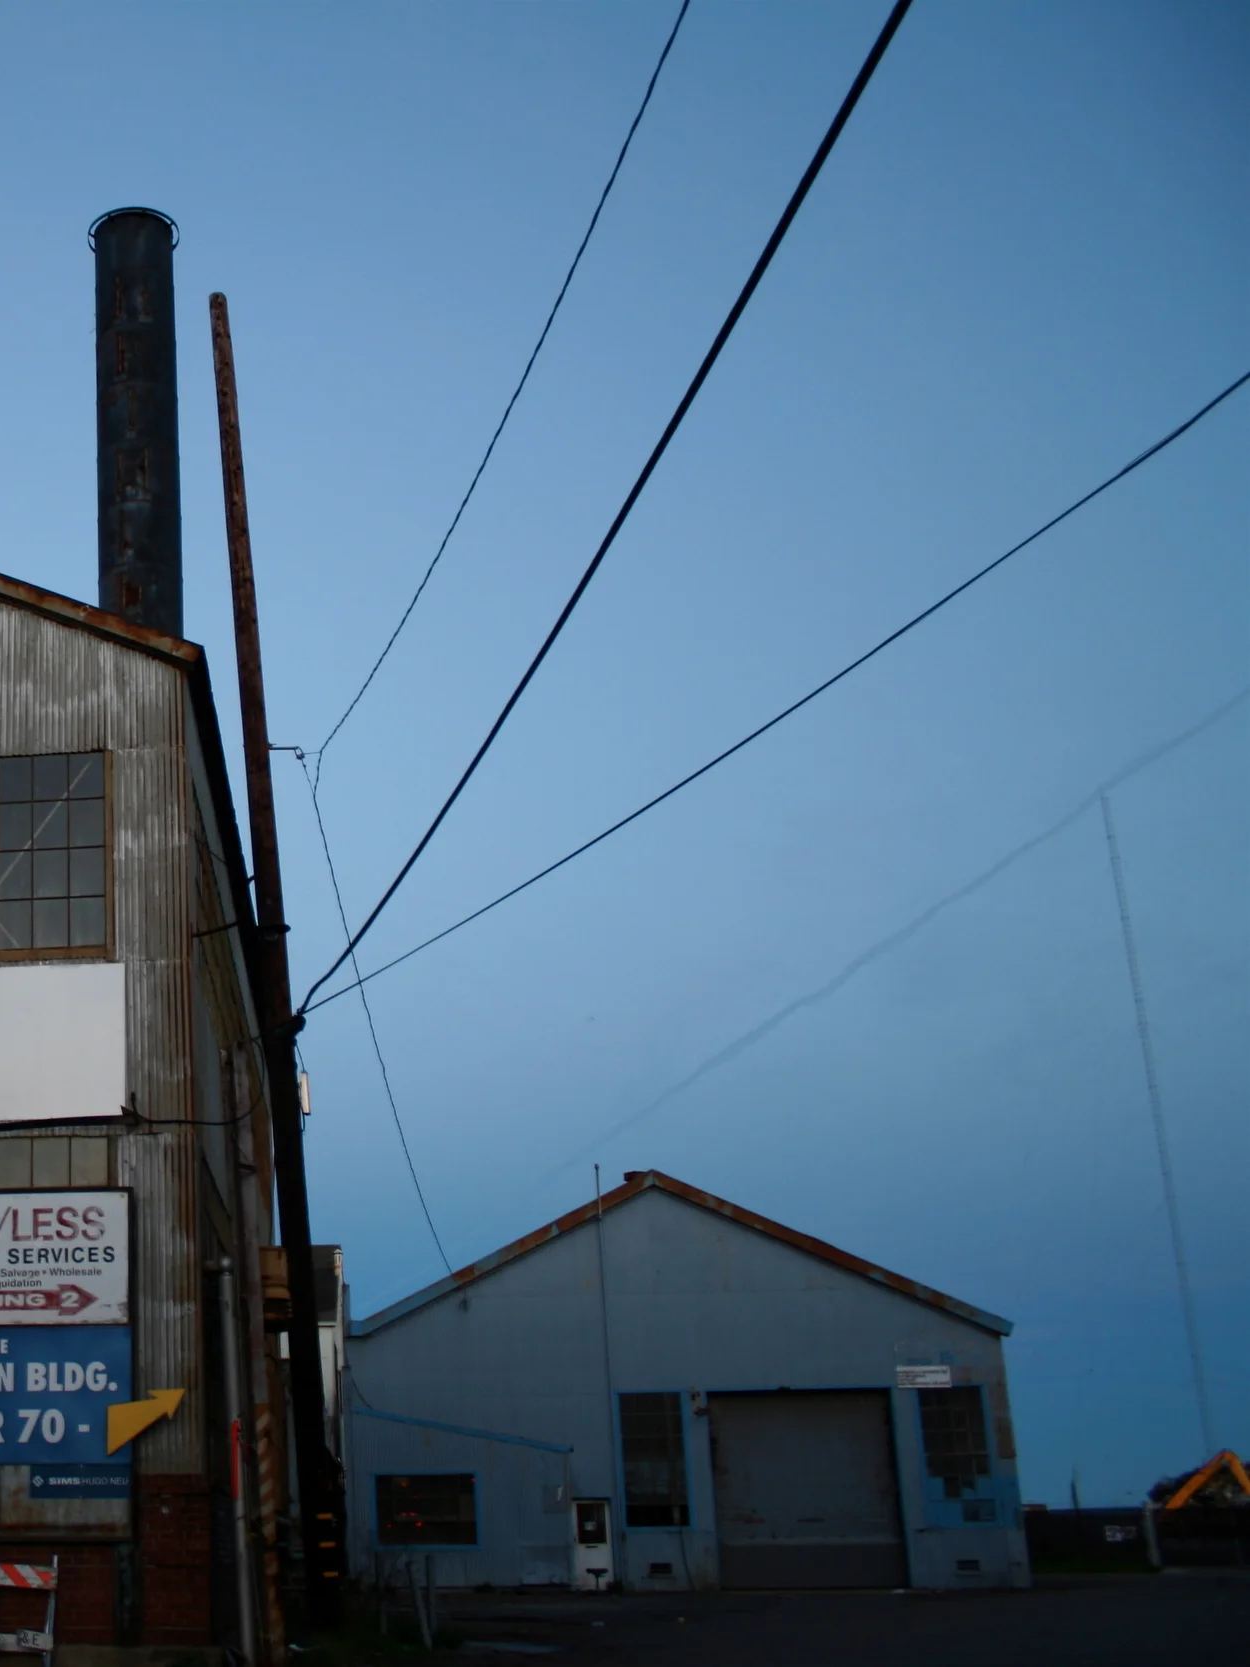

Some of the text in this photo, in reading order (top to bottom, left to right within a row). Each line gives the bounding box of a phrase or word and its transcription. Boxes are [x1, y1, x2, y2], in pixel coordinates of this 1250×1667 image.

[7, 1246, 115, 1265] SERVICES
[0, 1267, 40, 1280] Salvage
[49, 1266, 102, 1277] Wholesale
[59, 1291, 80, 1308] 2
[26, 1361, 119, 1392] BLDG.
[17, 1408, 66, 1444] 70
